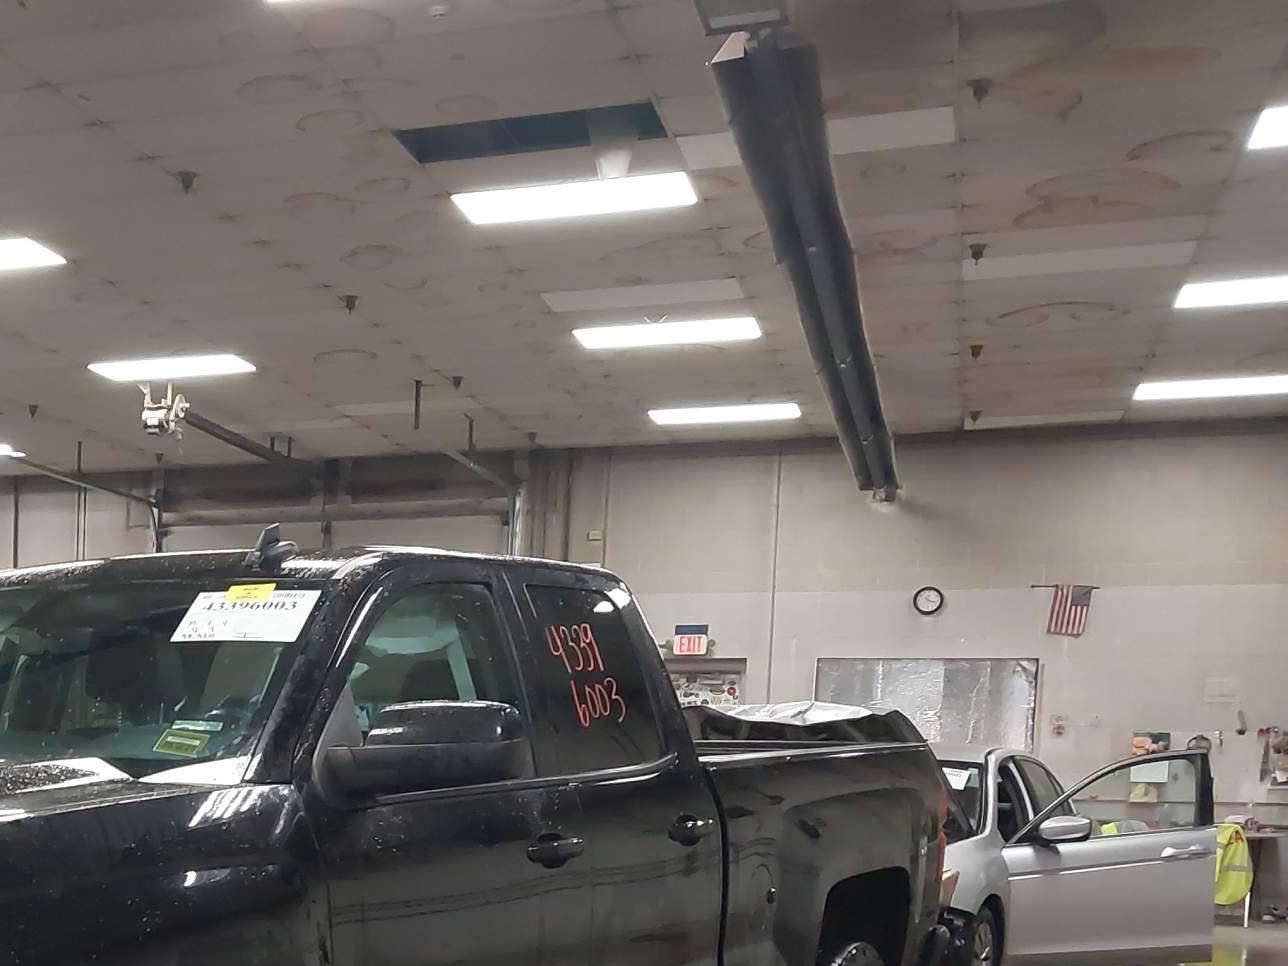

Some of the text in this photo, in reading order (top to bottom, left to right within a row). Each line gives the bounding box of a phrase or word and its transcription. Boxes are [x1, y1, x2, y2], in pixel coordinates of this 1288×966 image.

[202, 601, 299, 612] 43396003
[545, 623, 604, 674] 4339
[679, 636, 703, 653] EXIT
[571, 677, 626, 727] 6003
